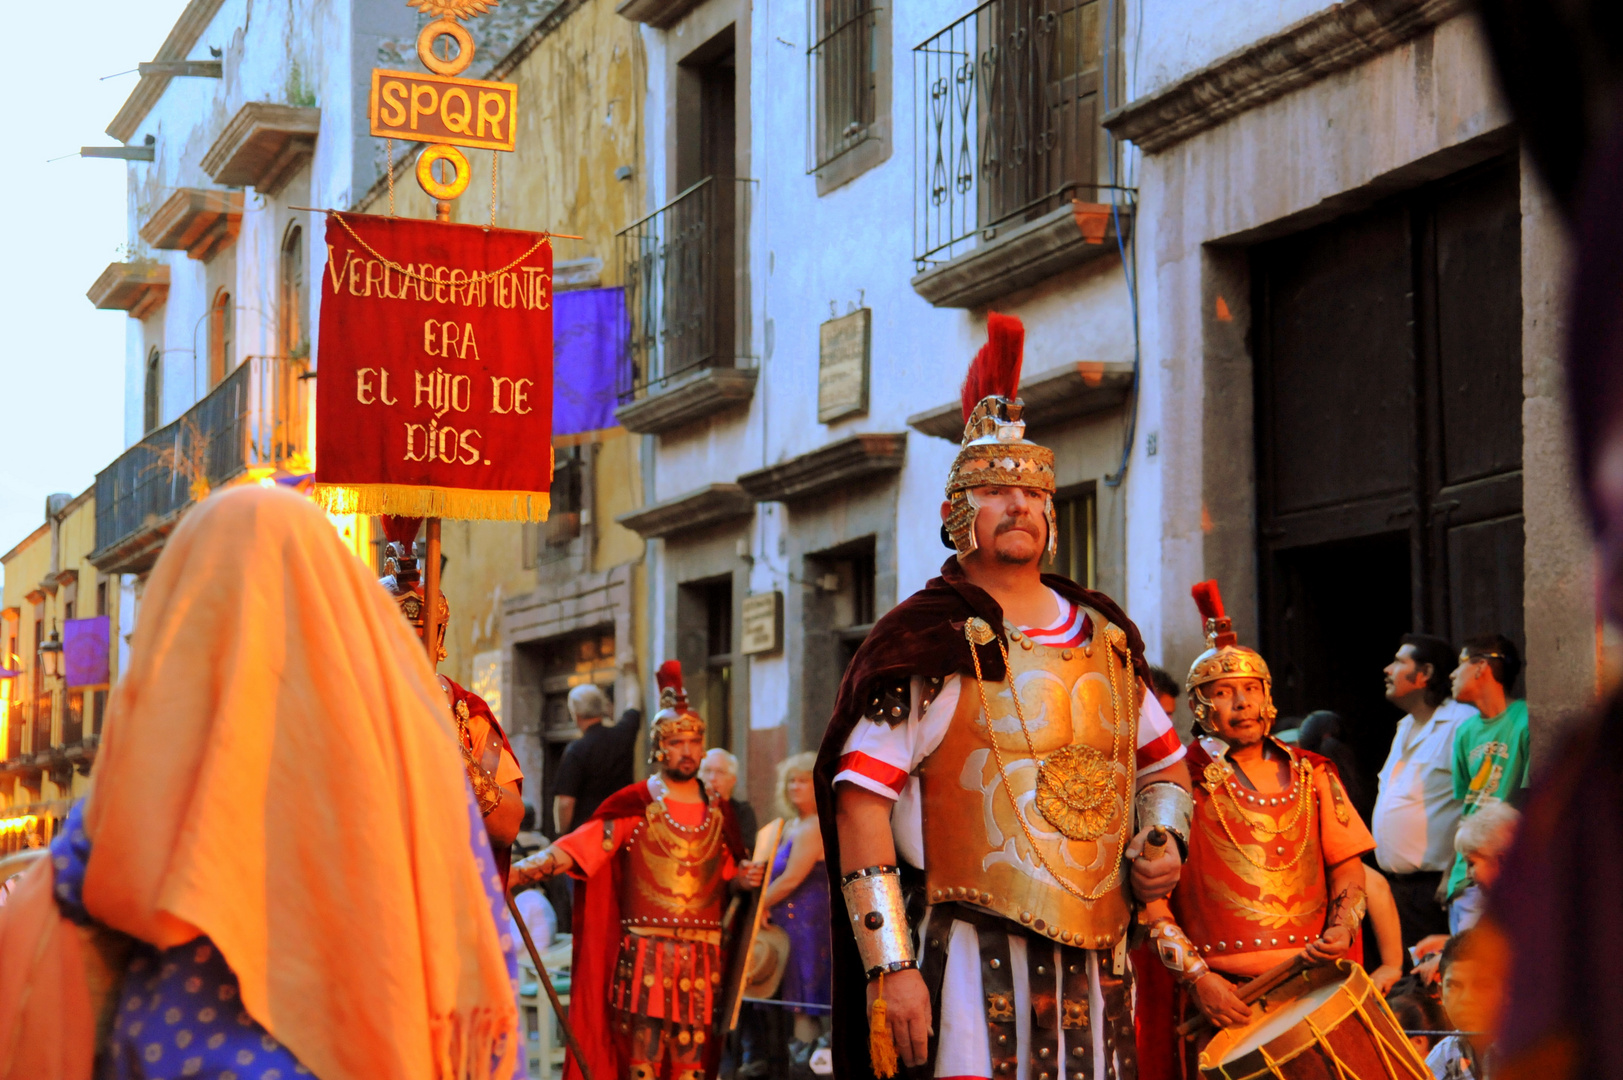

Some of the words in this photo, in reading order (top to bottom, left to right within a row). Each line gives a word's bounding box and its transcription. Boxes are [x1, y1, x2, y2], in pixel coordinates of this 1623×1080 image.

[380, 80, 507, 140] SPQR
[327, 244, 552, 311] VERDADERAMENTE
[424, 318, 481, 361] ERA
[355, 366, 398, 406] EL
[489, 375, 535, 415] DE
